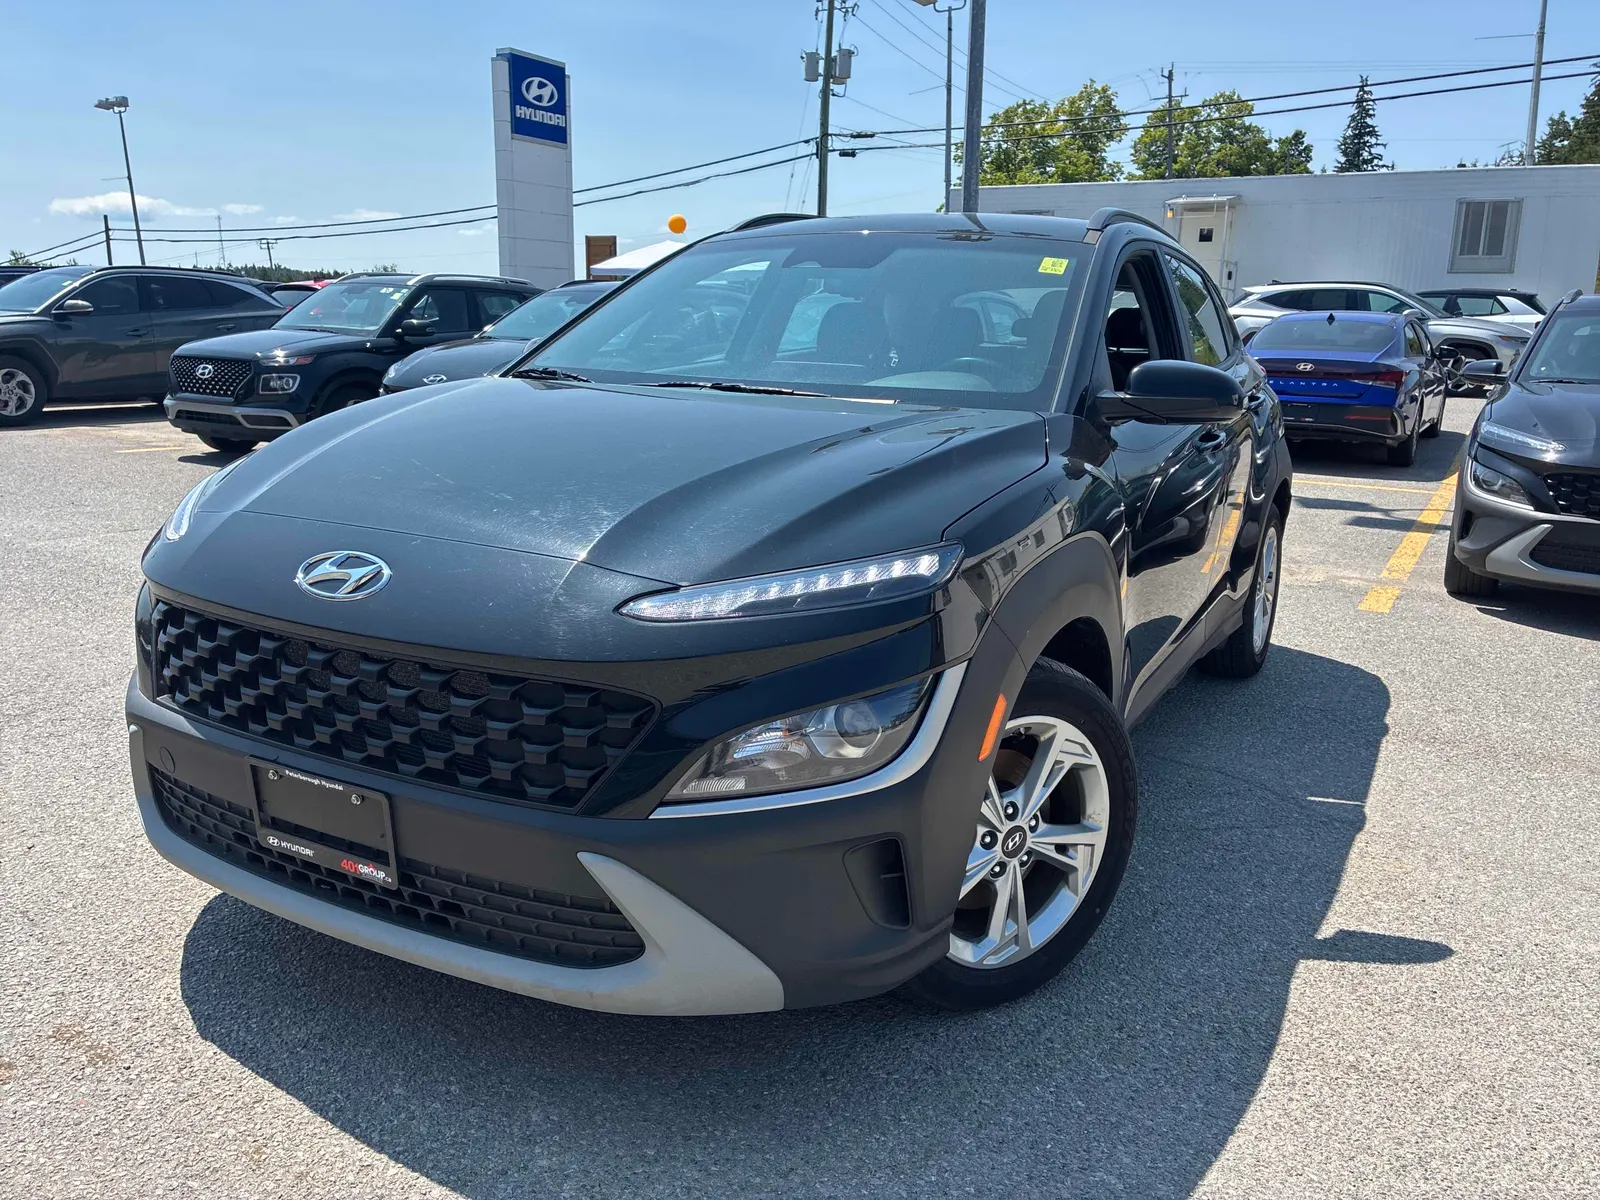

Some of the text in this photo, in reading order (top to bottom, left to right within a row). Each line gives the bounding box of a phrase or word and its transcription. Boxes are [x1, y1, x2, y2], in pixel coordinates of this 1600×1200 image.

[515, 105, 566, 127] HYUNDAI
[285, 769, 344, 791] Peterborough Hyundai
[280, 841, 314, 857] HYUNDAI
